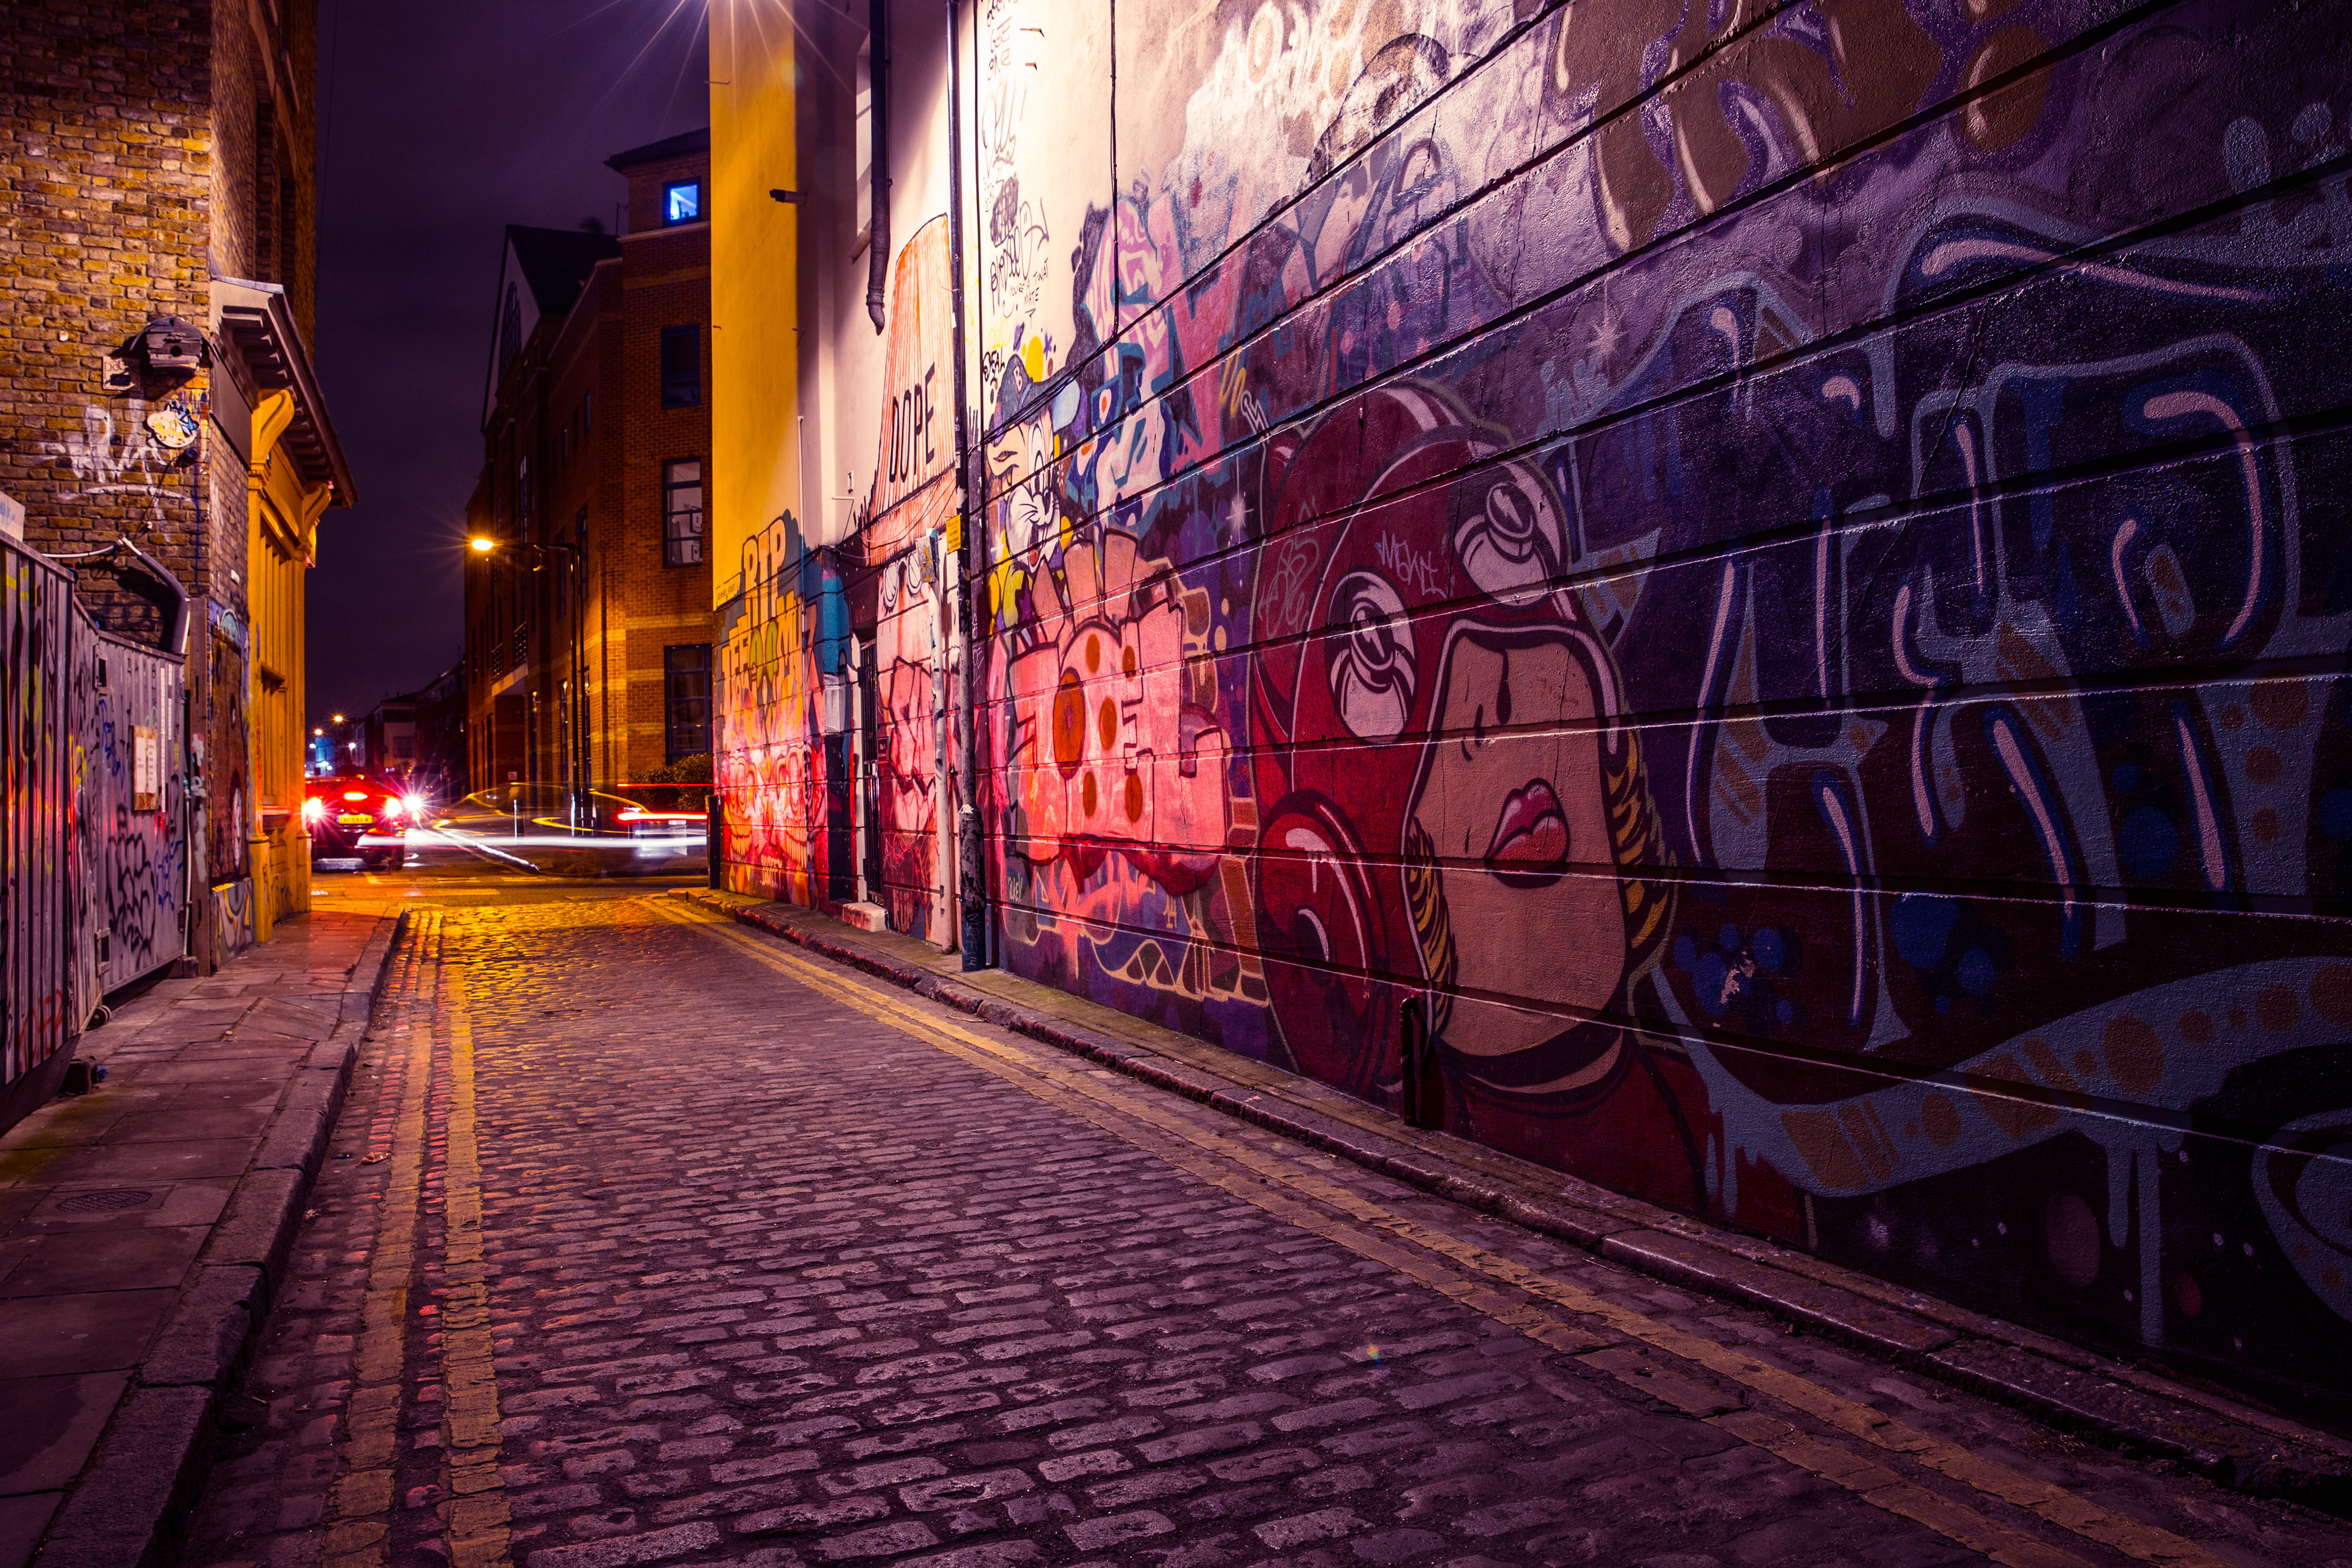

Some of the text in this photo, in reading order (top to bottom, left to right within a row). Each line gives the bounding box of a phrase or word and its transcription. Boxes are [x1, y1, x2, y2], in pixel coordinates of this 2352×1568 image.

[1023, 287, 1040, 307] MATE
[1033, 257, 1049, 285] TWAT
[889, 361, 935, 483] DOPE
[742, 516, 786, 622] RIP
